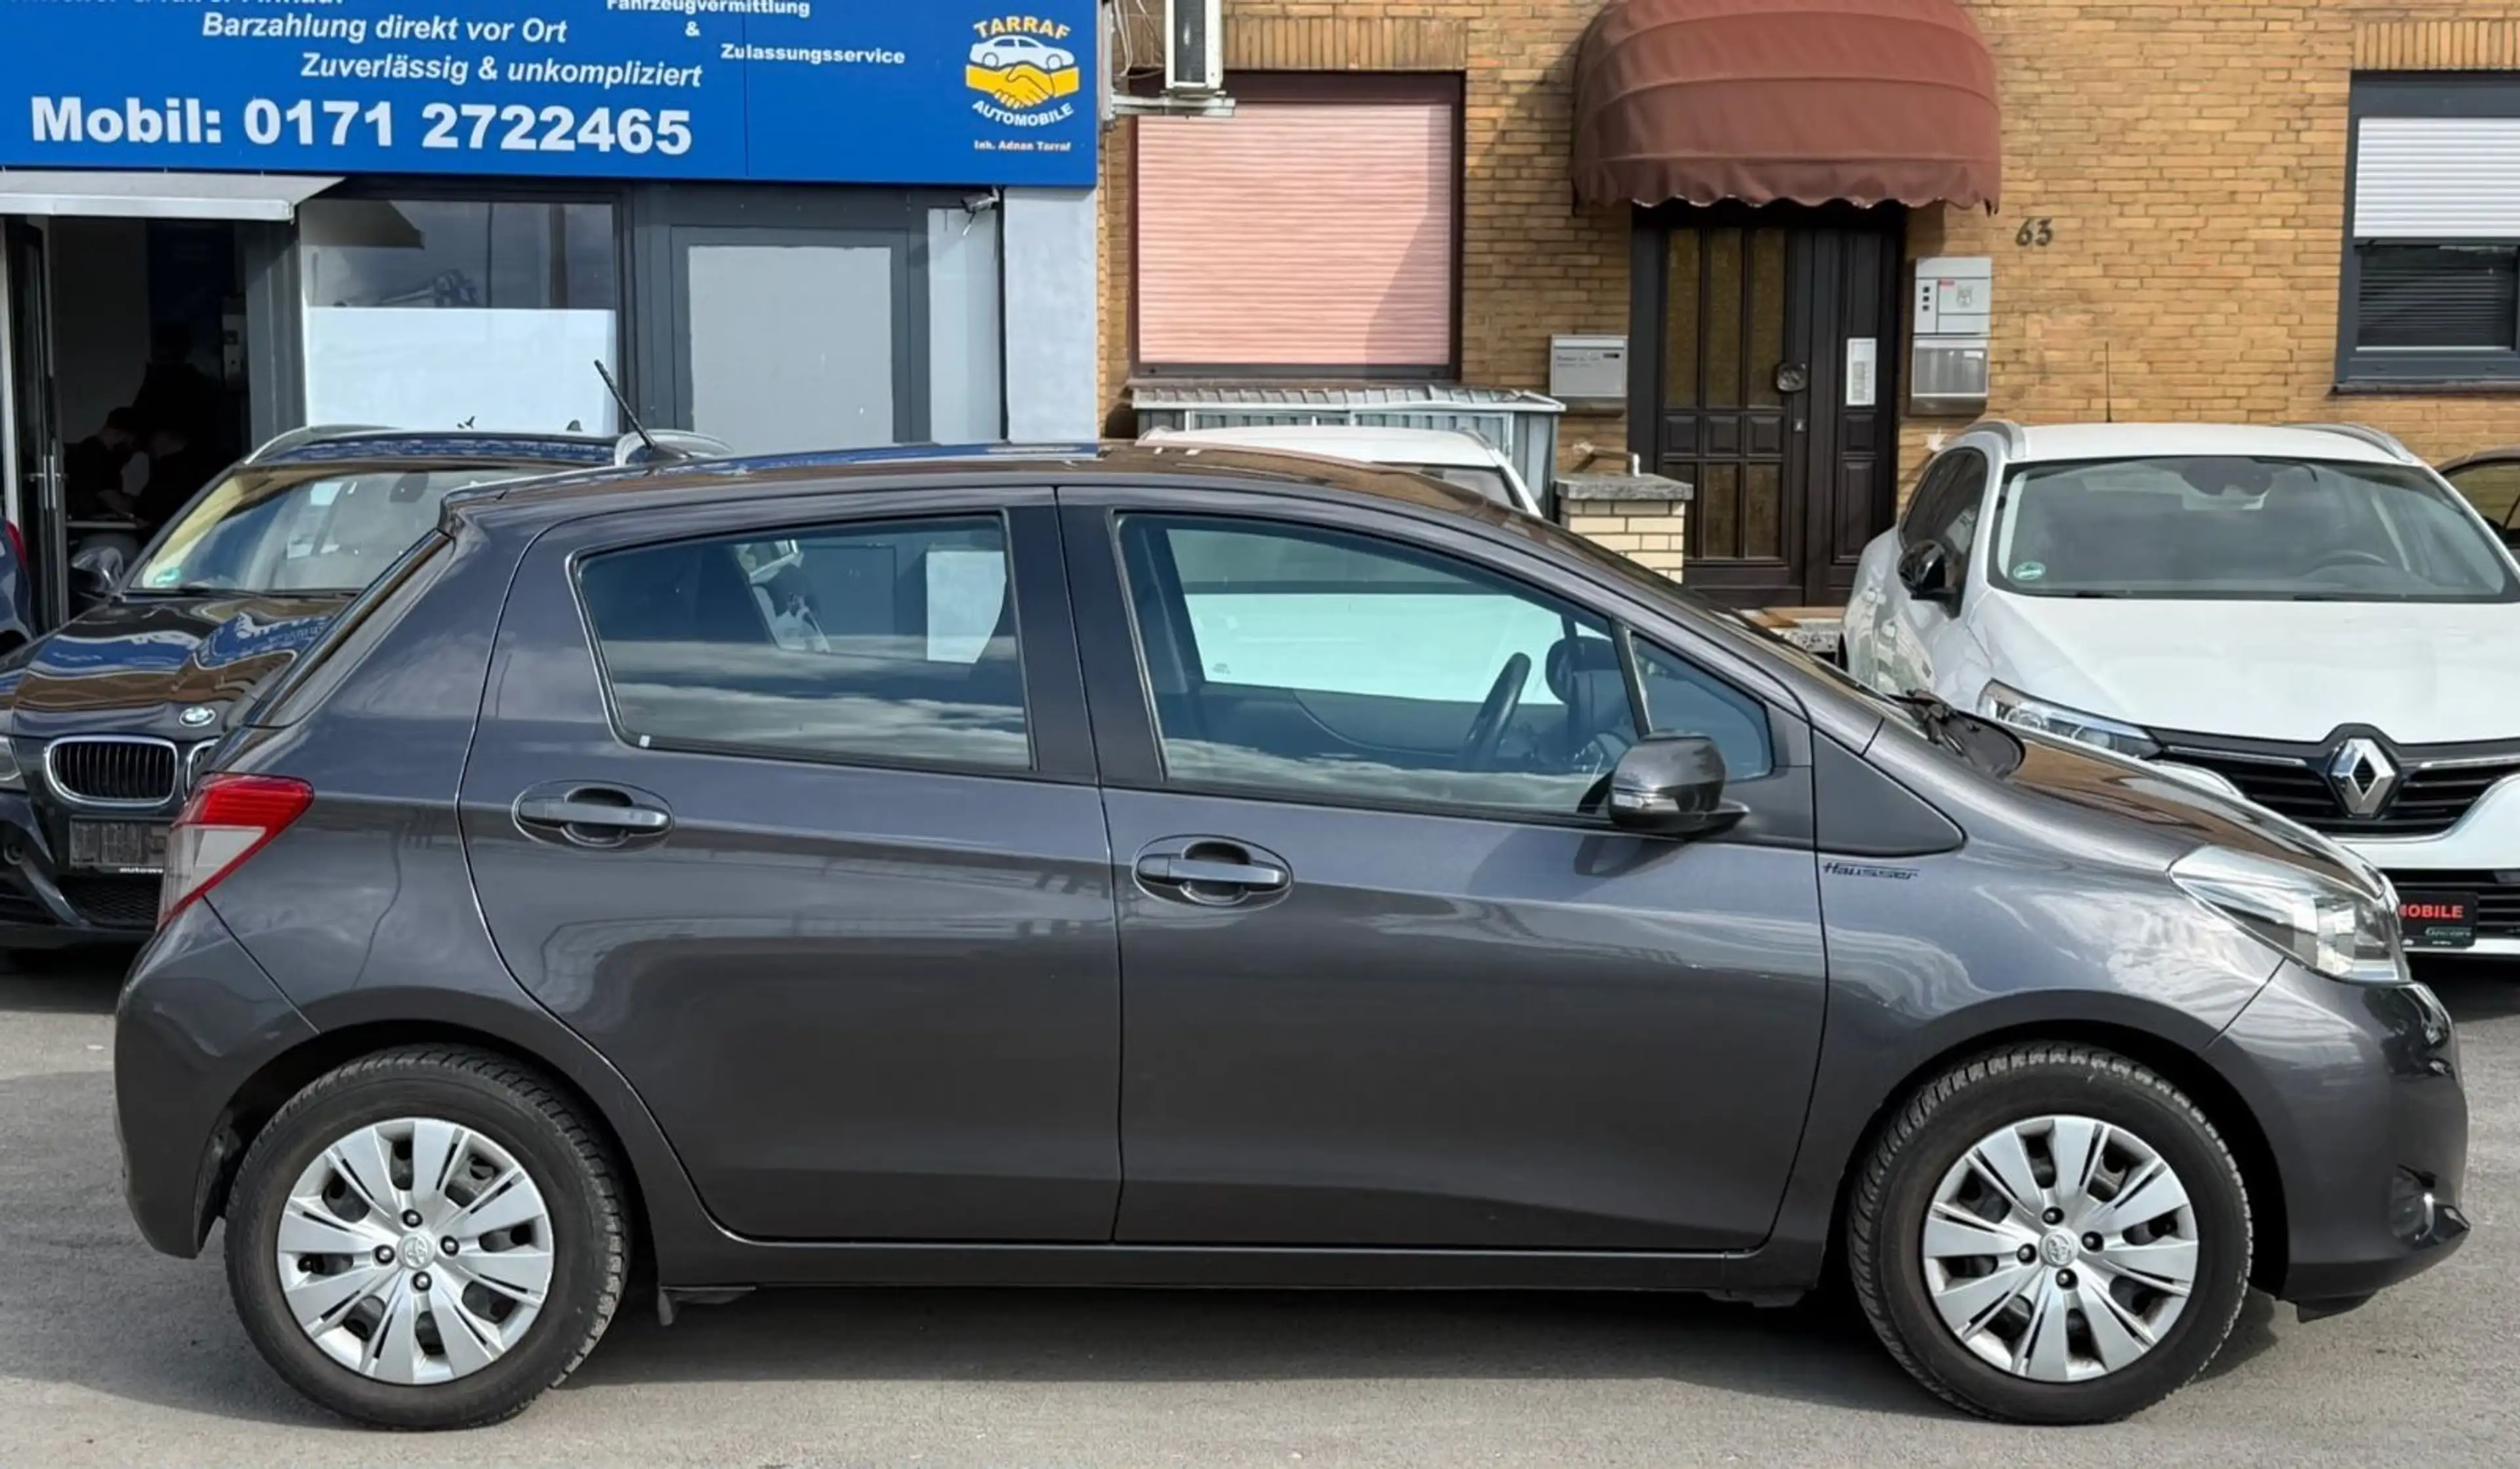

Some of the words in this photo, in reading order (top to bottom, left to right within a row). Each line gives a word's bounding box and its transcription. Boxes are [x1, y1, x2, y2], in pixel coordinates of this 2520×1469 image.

[202, 11, 367, 45] Barzahlung
[375, 14, 459, 41] direkt
[466, 21, 515, 41] vor
[522, 16, 568, 43] Ort
[684, 21, 701, 37] &
[973, 16, 1072, 39] TARRAF
[721, 43, 906, 64] Zulassungsservice
[300, 51, 469, 86] Zuverlässig
[478, 55, 498, 81] &
[507, 57, 704, 90] unkompliziert
[31, 96, 222, 144] Mobil:
[243, 98, 392, 147] 0171
[421, 102, 692, 155] 2722465
[971, 100, 1074, 127] AUTOMOBILE
[974, 140, 996, 150] Inh.
[2015, 217, 2053, 247] 63
